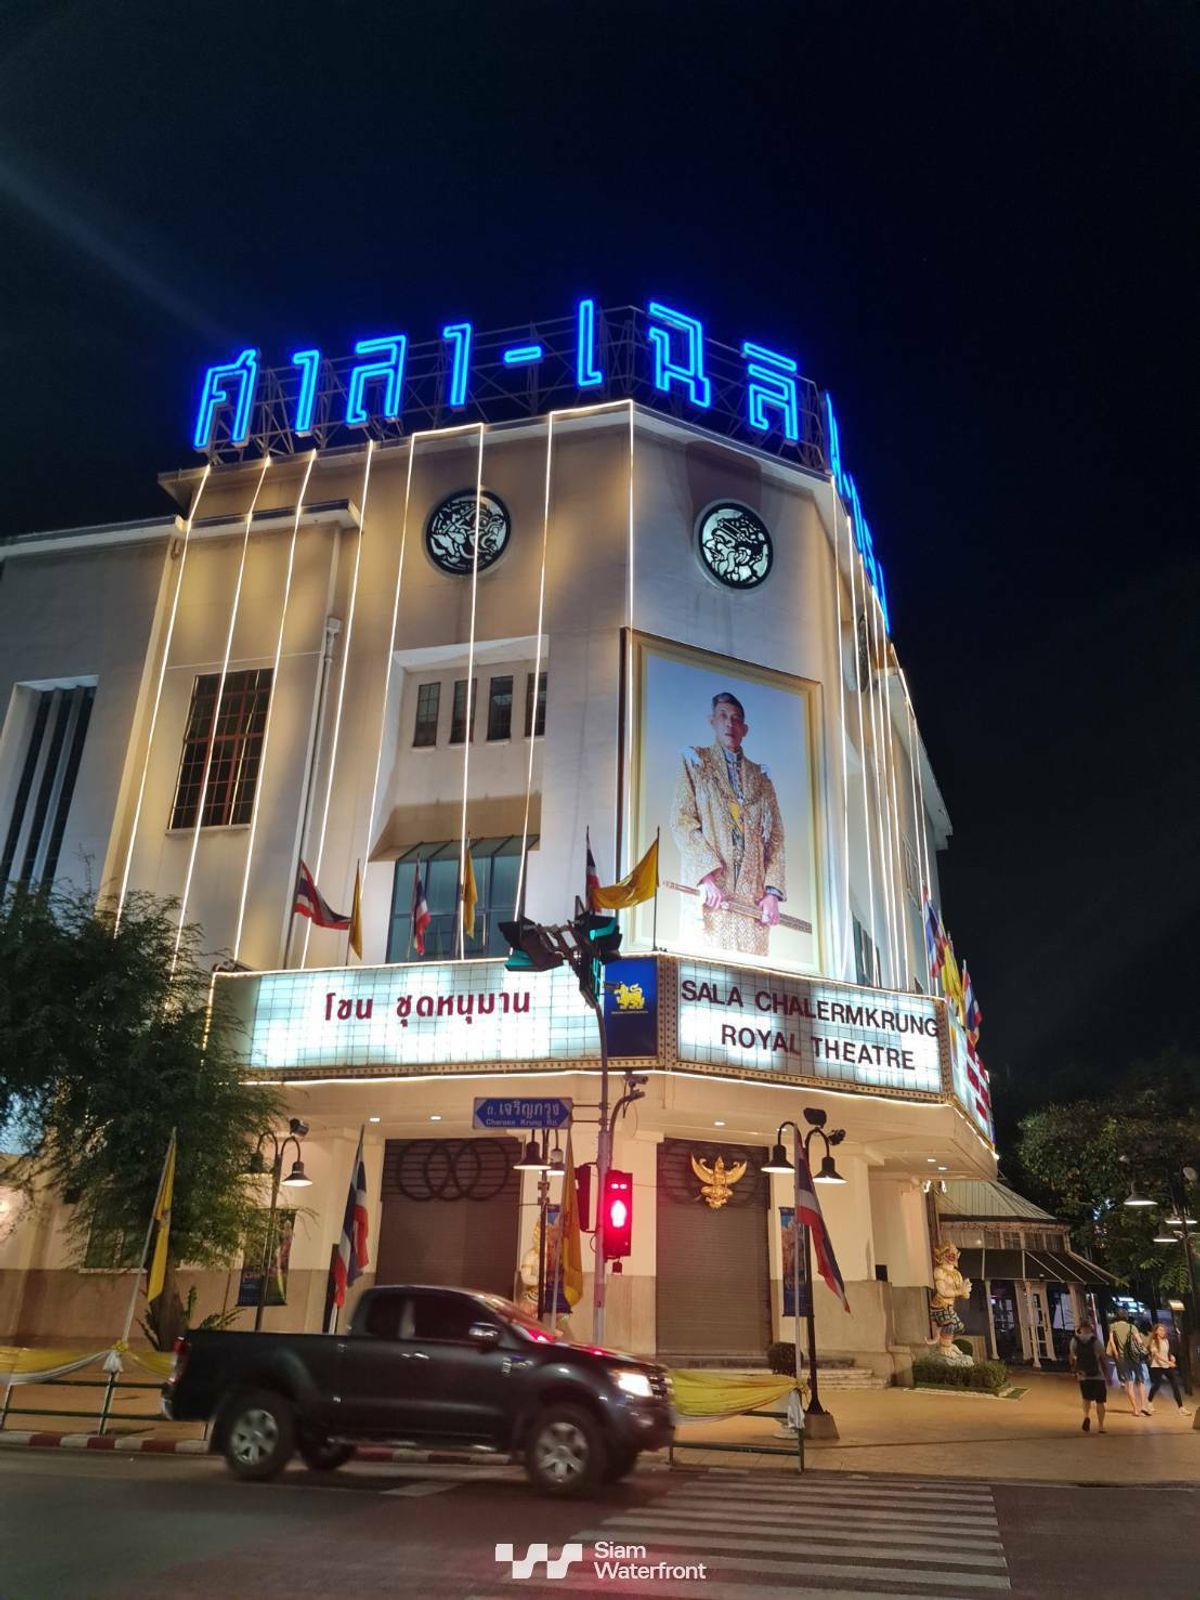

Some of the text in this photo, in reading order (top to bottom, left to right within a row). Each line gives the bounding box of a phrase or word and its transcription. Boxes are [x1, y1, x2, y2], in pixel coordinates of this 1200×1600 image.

[325, 992, 530, 1027] โขน ชุดหนุมาน
[681, 979, 940, 1037] SALA CHALERMKRUNG
[721, 1024, 916, 1070] ROYAL THEATRE
